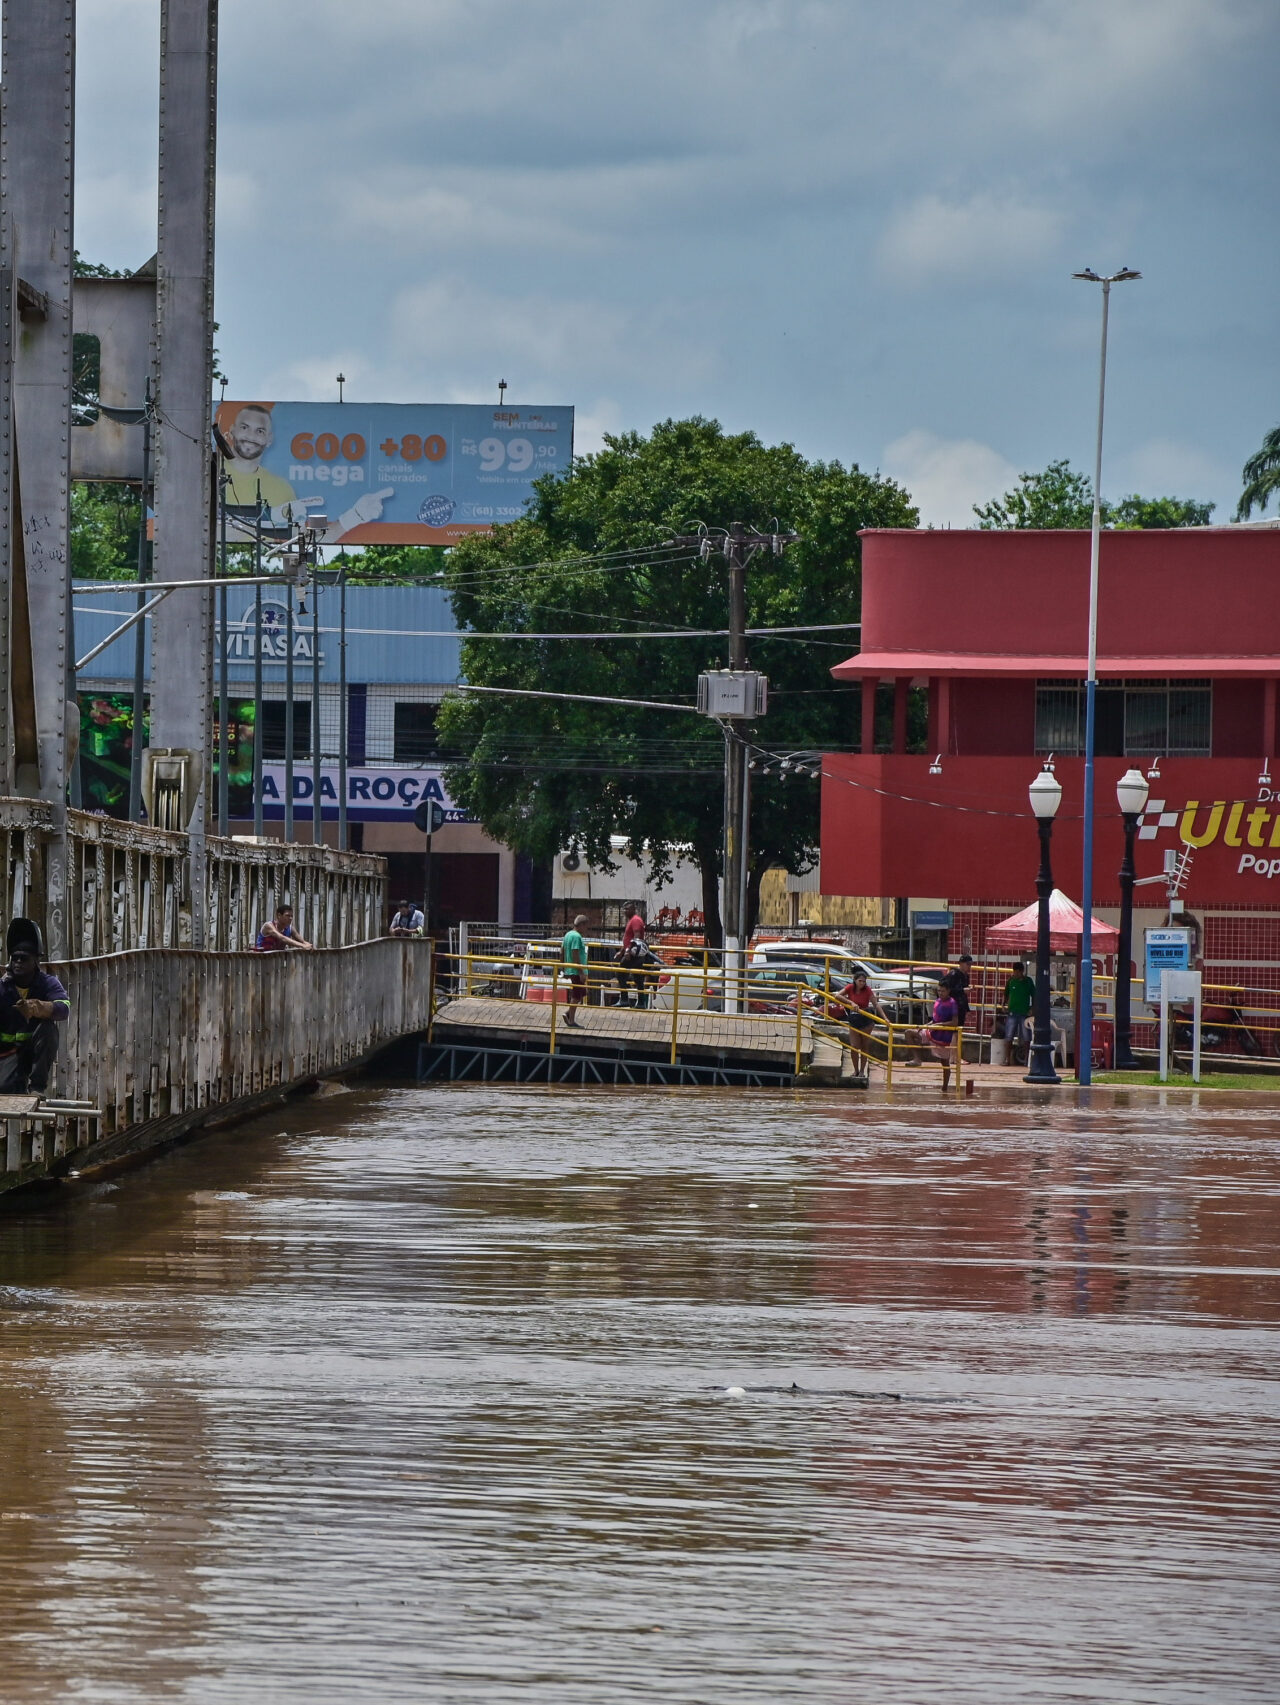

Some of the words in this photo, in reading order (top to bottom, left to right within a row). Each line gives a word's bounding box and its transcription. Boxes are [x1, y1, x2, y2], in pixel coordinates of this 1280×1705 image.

[290, 432, 366, 461] 600
[380, 434, 447, 461] +80
[289, 465, 365, 486] mega
[378, 464, 413, 473] canais
[378, 472, 428, 483] liberados
[418, 502, 455, 521] INTERNET
[292, 776, 337, 799] DA
[348, 777, 444, 807] ROÇA
